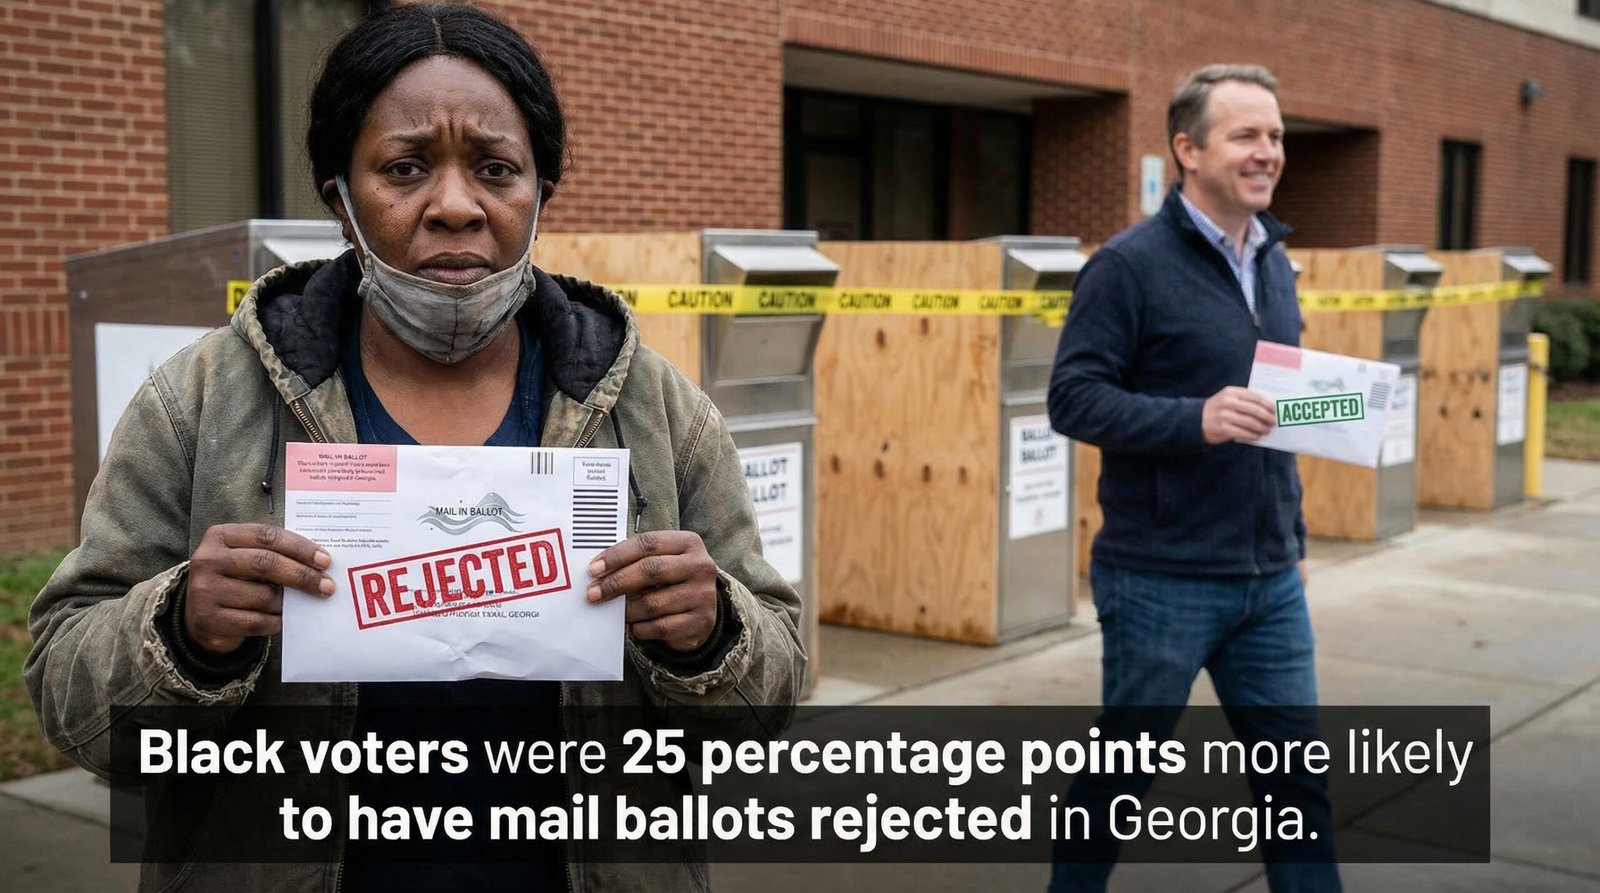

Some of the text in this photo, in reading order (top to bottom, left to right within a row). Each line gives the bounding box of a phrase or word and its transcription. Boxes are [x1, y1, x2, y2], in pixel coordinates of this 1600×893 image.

[667, 291, 733, 307] CAUTION
[758, 292, 816, 308] CAUTION
[839, 293, 892, 309] CAUTION
[912, 294, 960, 309] CAUTION
[979, 295, 1023, 309] CAUTION
[1282, 398, 1359, 422] ACCEPTED
[435, 507, 503, 516] MAIL IN BALLOT
[360, 540, 559, 619] REJECTED
